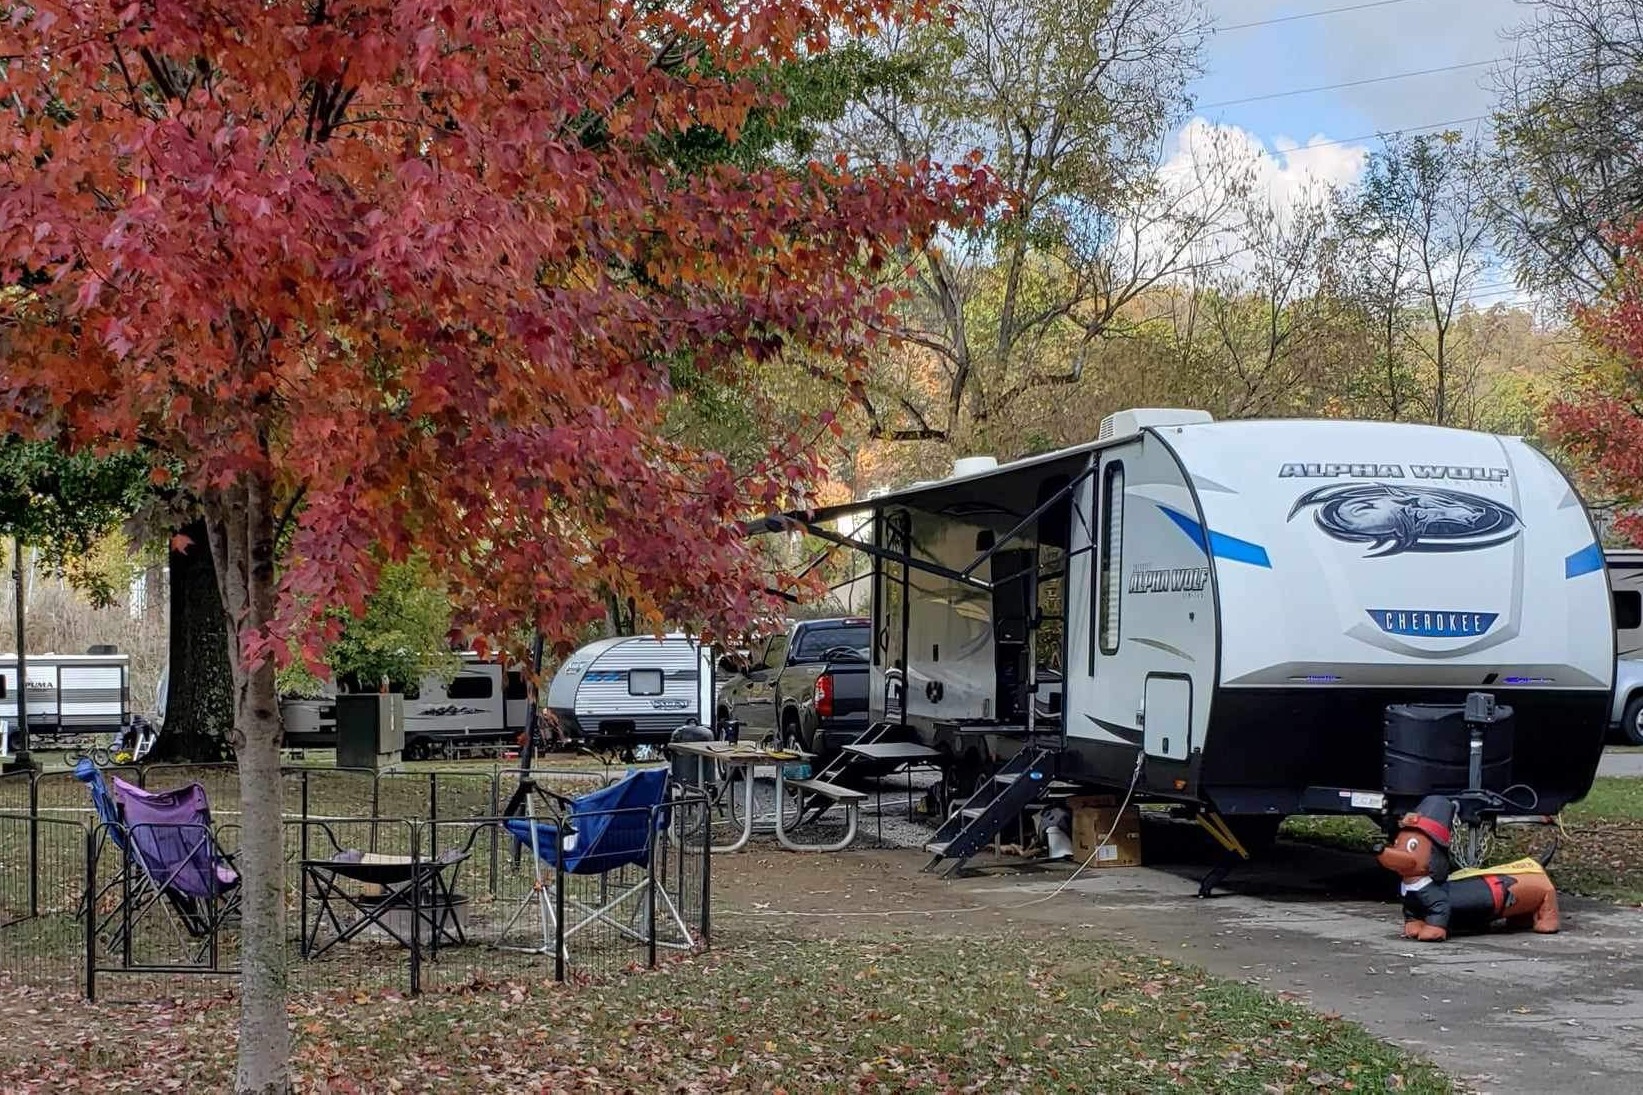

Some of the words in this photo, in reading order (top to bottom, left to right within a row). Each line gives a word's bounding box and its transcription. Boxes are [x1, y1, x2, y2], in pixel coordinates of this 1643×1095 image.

[1278, 463, 1405, 478] ALPHA
[1410, 464, 1509, 482] WOLF
[1129, 570, 1170, 593] ALPHA
[1171, 567, 1208, 592] WOLF
[1385, 612, 1481, 632] CHEROKEE
